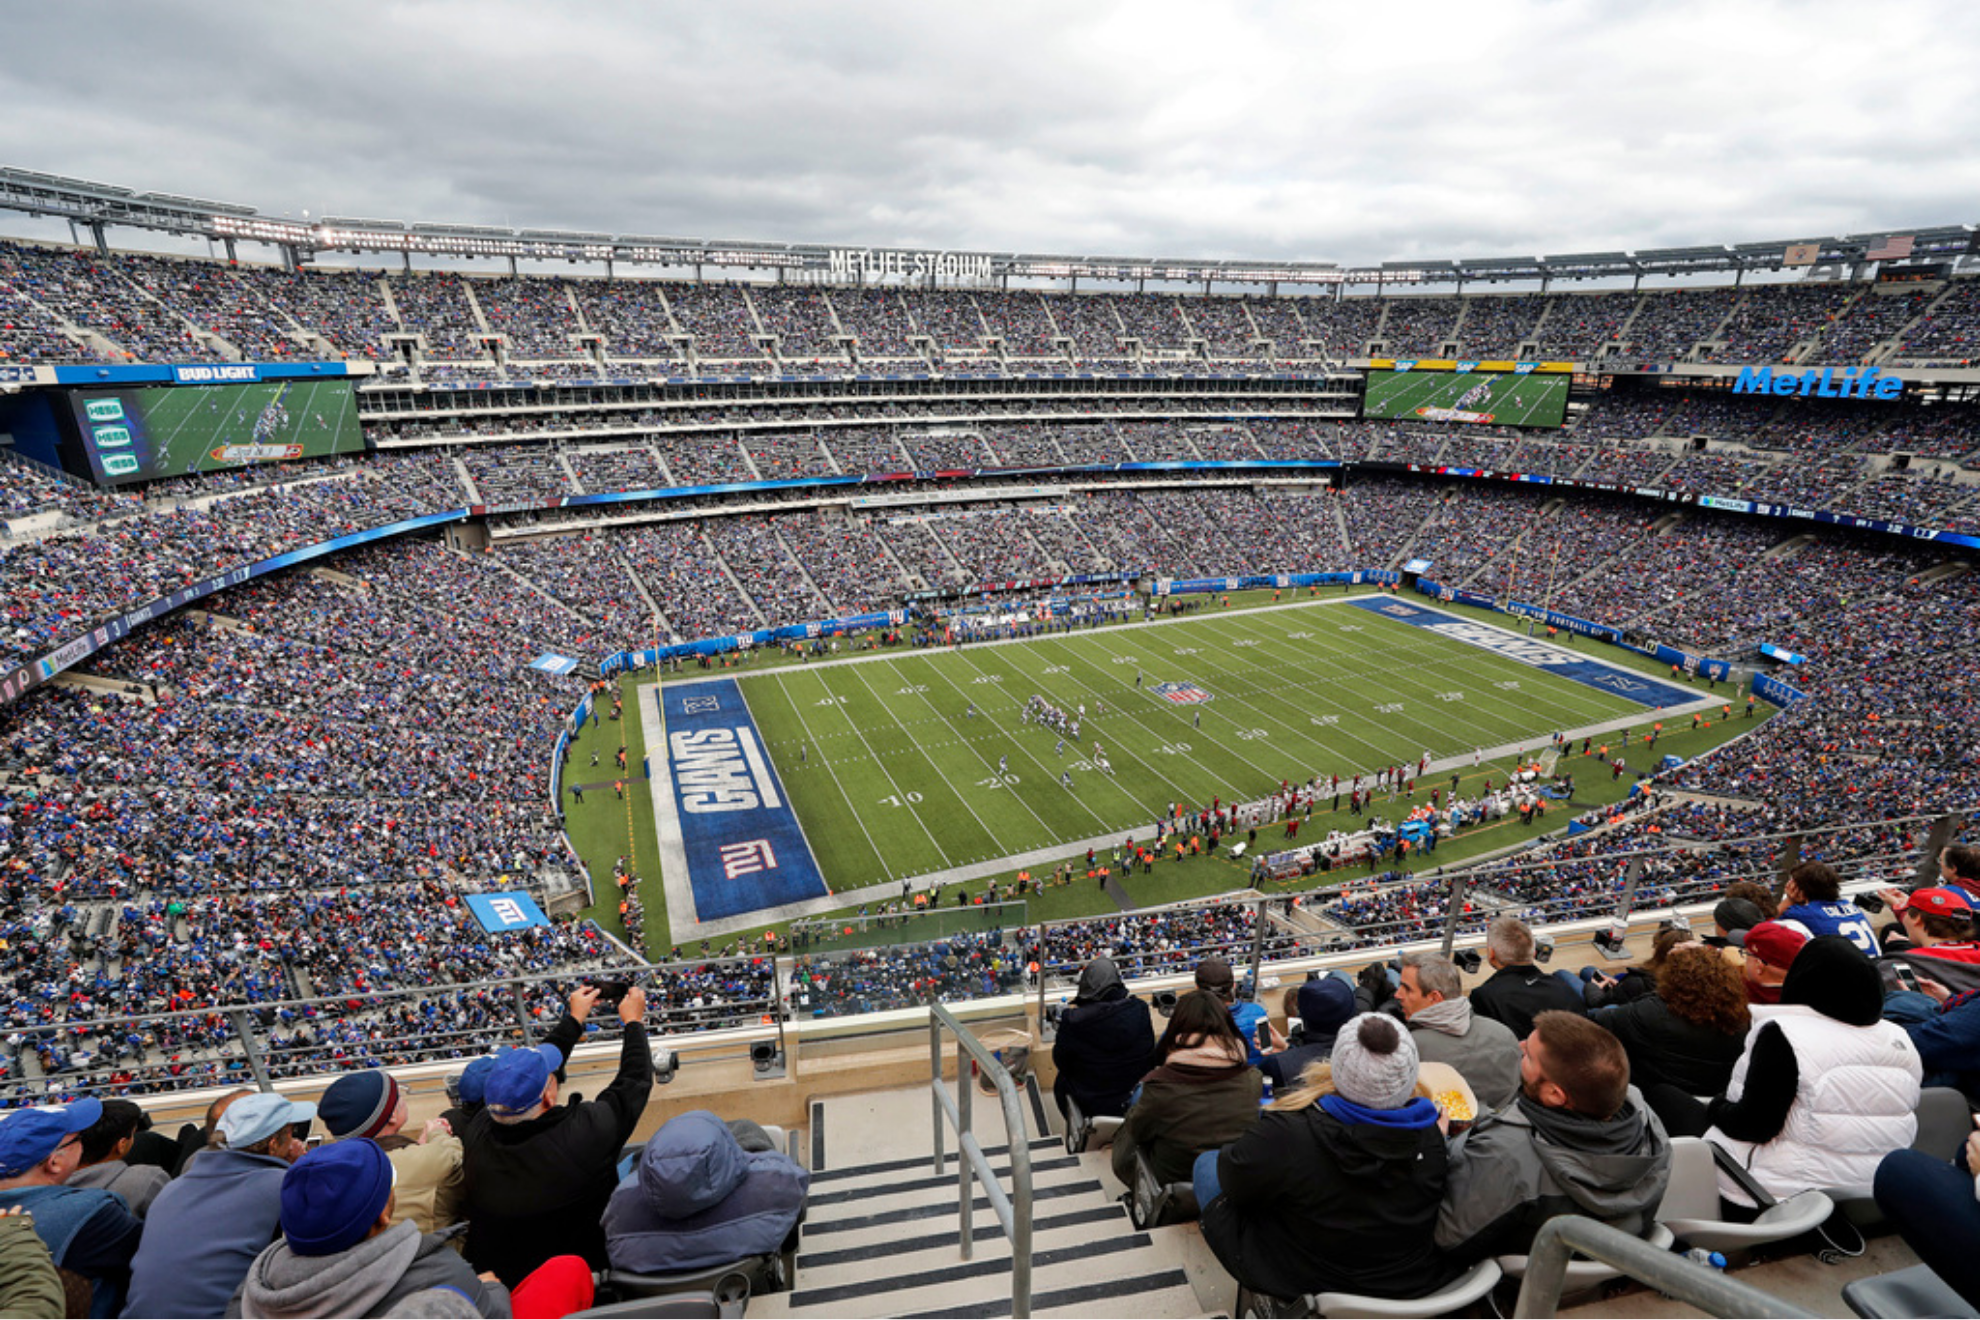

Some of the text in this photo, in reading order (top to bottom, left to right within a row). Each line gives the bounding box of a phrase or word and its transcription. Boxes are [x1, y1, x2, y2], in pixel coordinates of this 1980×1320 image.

[830, 249, 992, 278] METLIFE STADIUM
[177, 366, 256, 381] BUD LIGHT
[1396, 362, 1413, 372] SAP
[1457, 363, 1476, 373] SAP
[1516, 364, 1534, 373] SAP
[1732, 366, 1903, 400] MetLife
[89, 405, 121, 415] HESS
[97, 432, 128, 442] HESS
[104, 458, 136, 468] HESS
[55, 638, 90, 667] MetLife
[1165, 689, 1208, 702] NFL
[670, 728, 760, 814] GIANTS
[983, 773, 1020, 790] 20
[885, 790, 924, 807] 10
